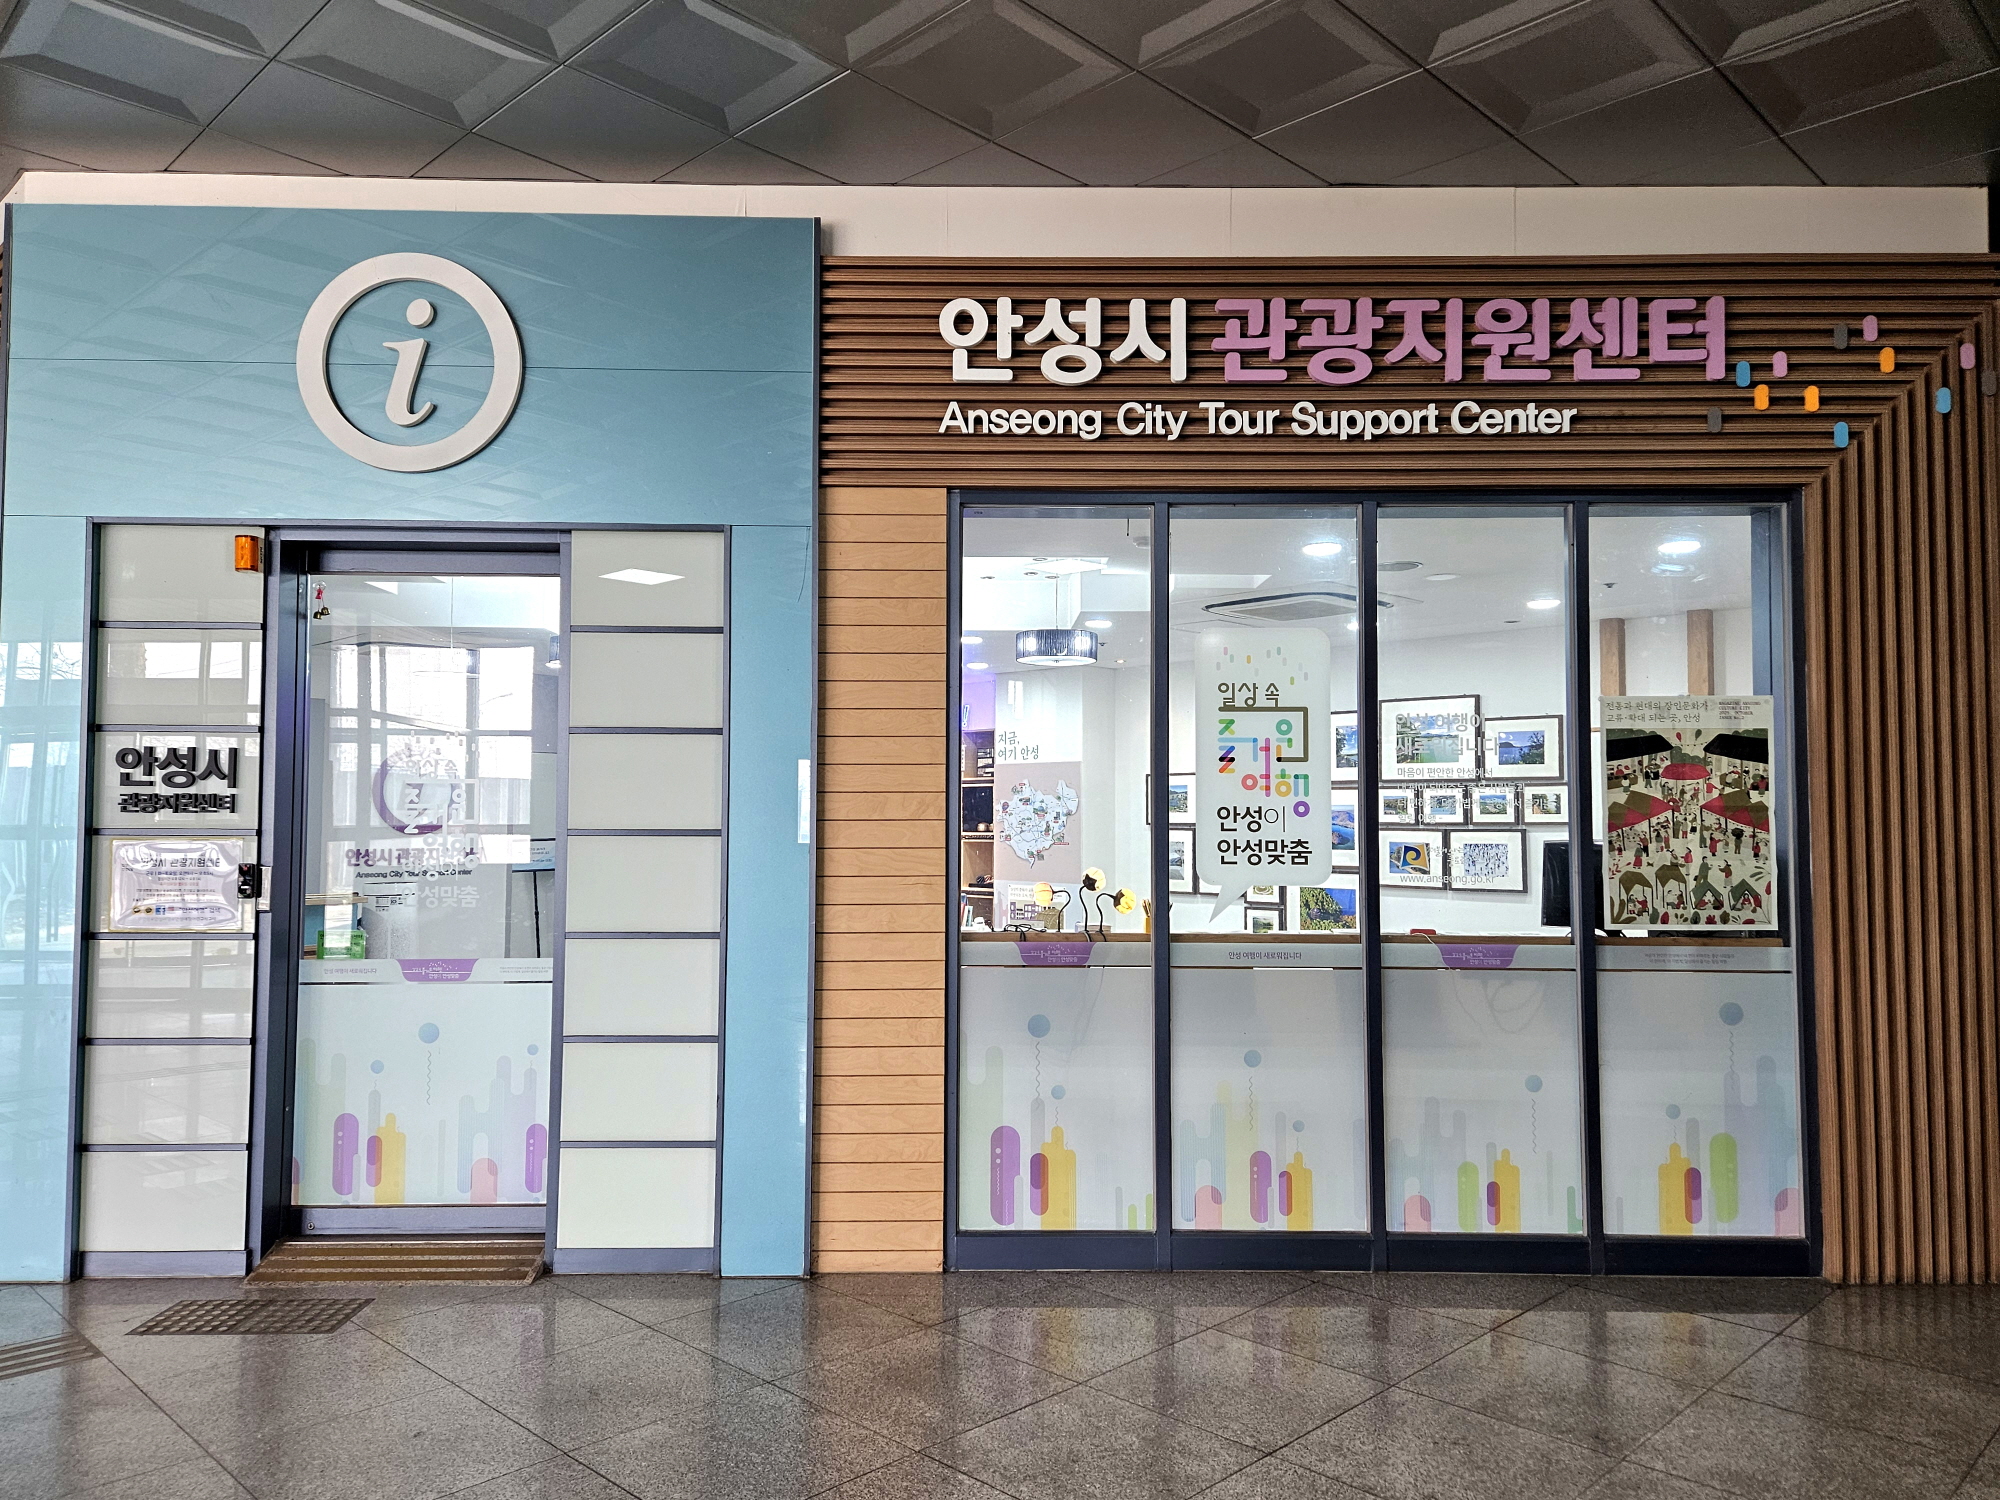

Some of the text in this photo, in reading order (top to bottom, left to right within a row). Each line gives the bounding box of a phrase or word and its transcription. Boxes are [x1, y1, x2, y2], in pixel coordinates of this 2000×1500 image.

[938, 295, 1727, 386] 안성시 관광지원센터
[938, 401, 1577, 441] Anseong City Tour Support Center
[1217, 682, 1281, 708] 일상 속
[1605, 701, 1632, 711] 전통과
[1636, 701, 1661, 711] 현대의
[1648, 713, 1667, 723] 되는
[1684, 714, 1701, 723] 안성
[998, 731, 1020, 746] 지금,
[998, 744, 1039, 761] 여기 안성
[115, 746, 240, 789] 안성시
[1397, 767, 1493, 779] 마음이 편안한 안성에서
[118, 793, 239, 814] 관광지원센터
[1217, 805, 1286, 832] 안성이
[1217, 839, 1312, 865] 안성맞춤
[1400, 875, 1494, 885] www.anseong.go.kr
